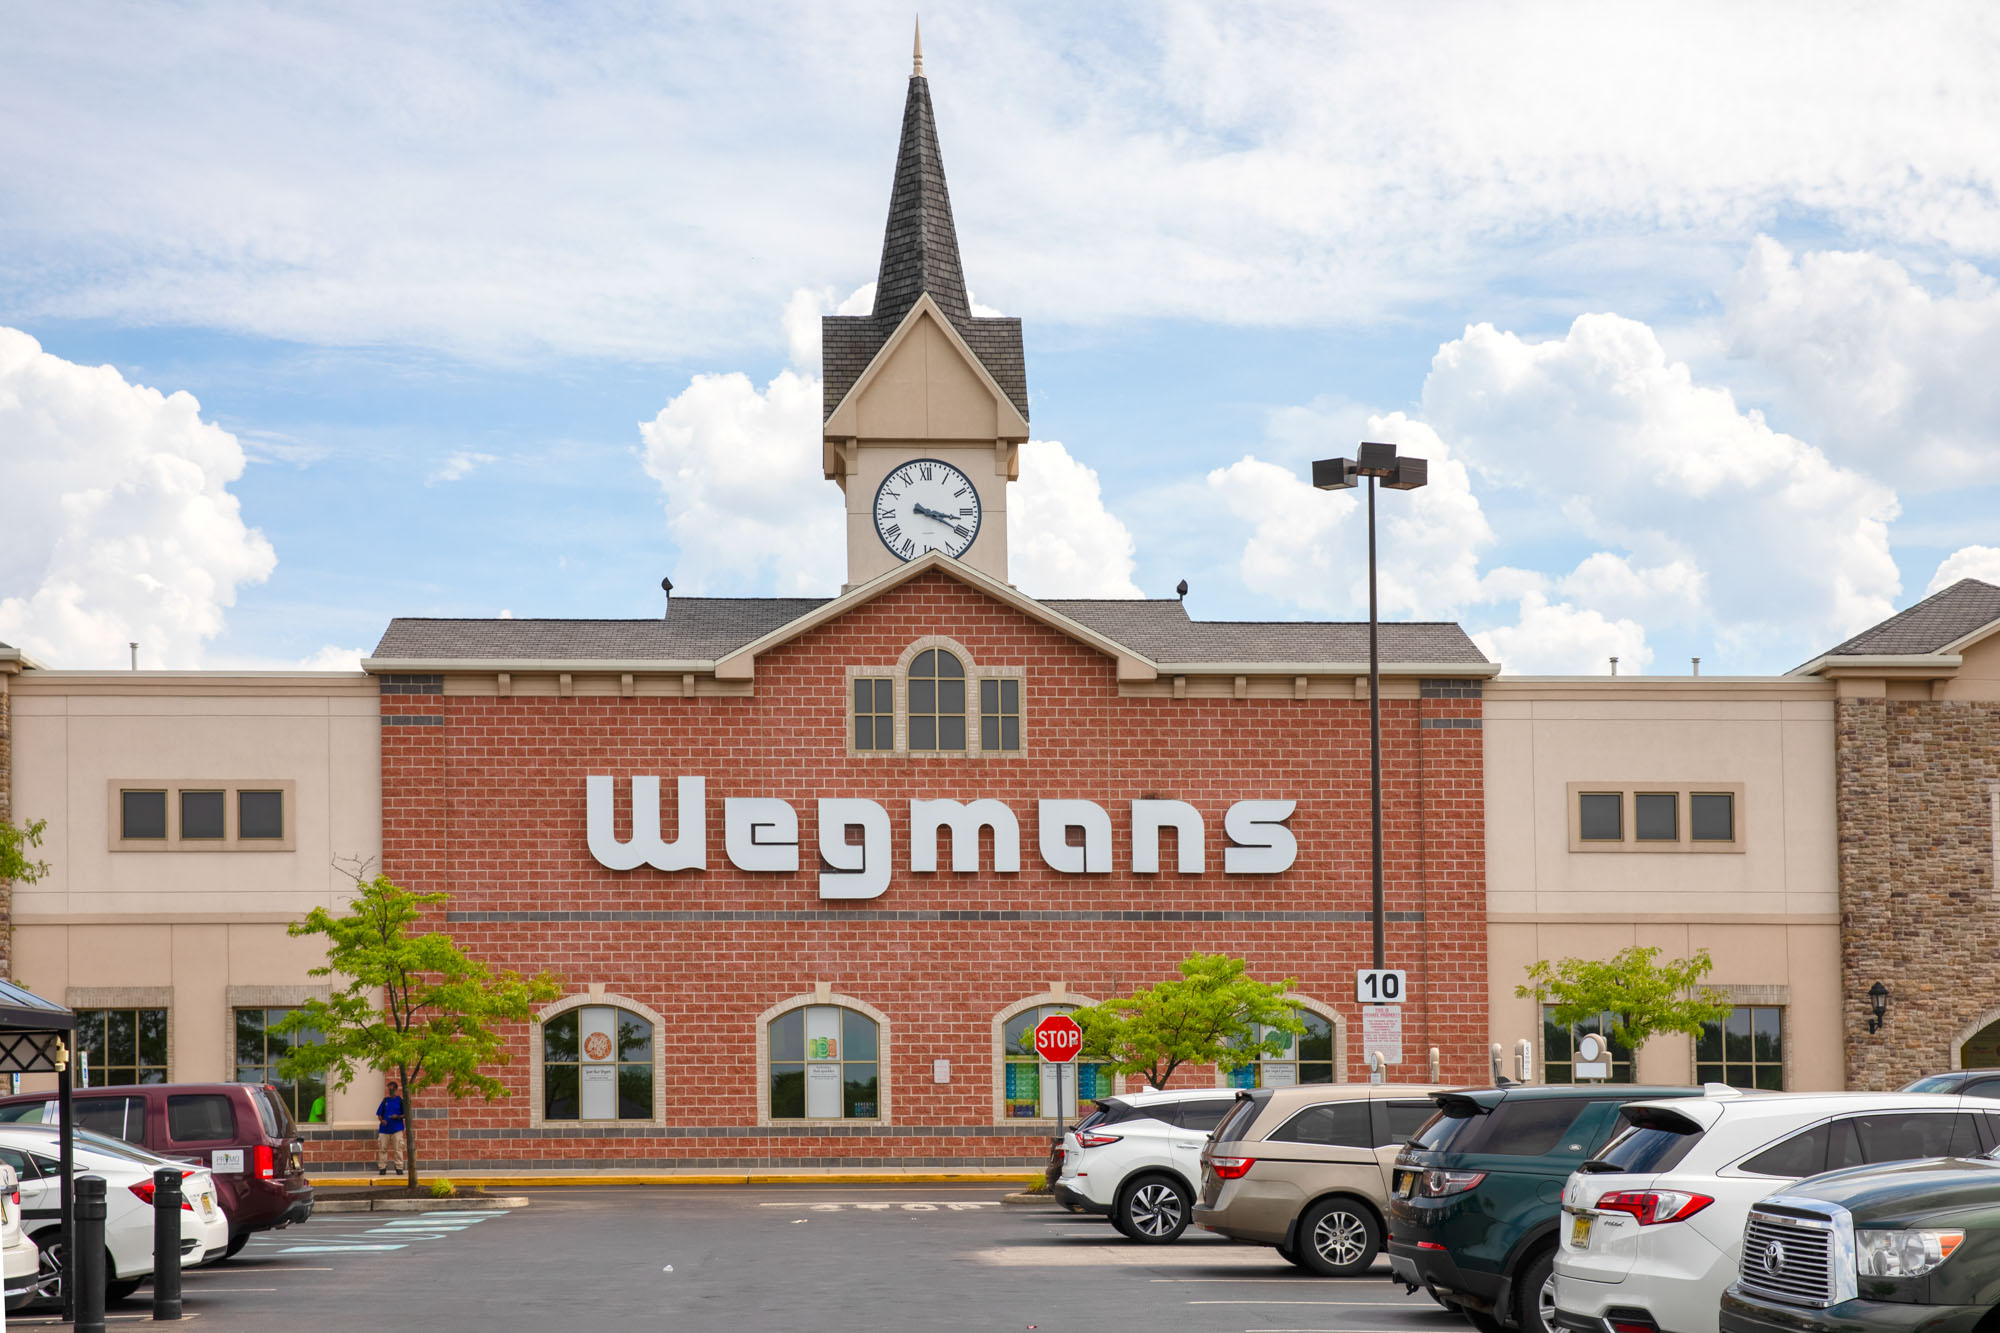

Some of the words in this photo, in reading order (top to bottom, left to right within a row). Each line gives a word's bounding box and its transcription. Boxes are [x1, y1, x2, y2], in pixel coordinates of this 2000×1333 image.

[920, 467, 933, 481] XII
[953, 487, 967, 498] II
[959, 508, 973, 516] III
[586, 774, 1297, 900] Wegmans
[1364, 973, 1399, 999] 10
[1038, 1030, 1079, 1048] STOP
[810, 1203, 983, 1212] STOP
